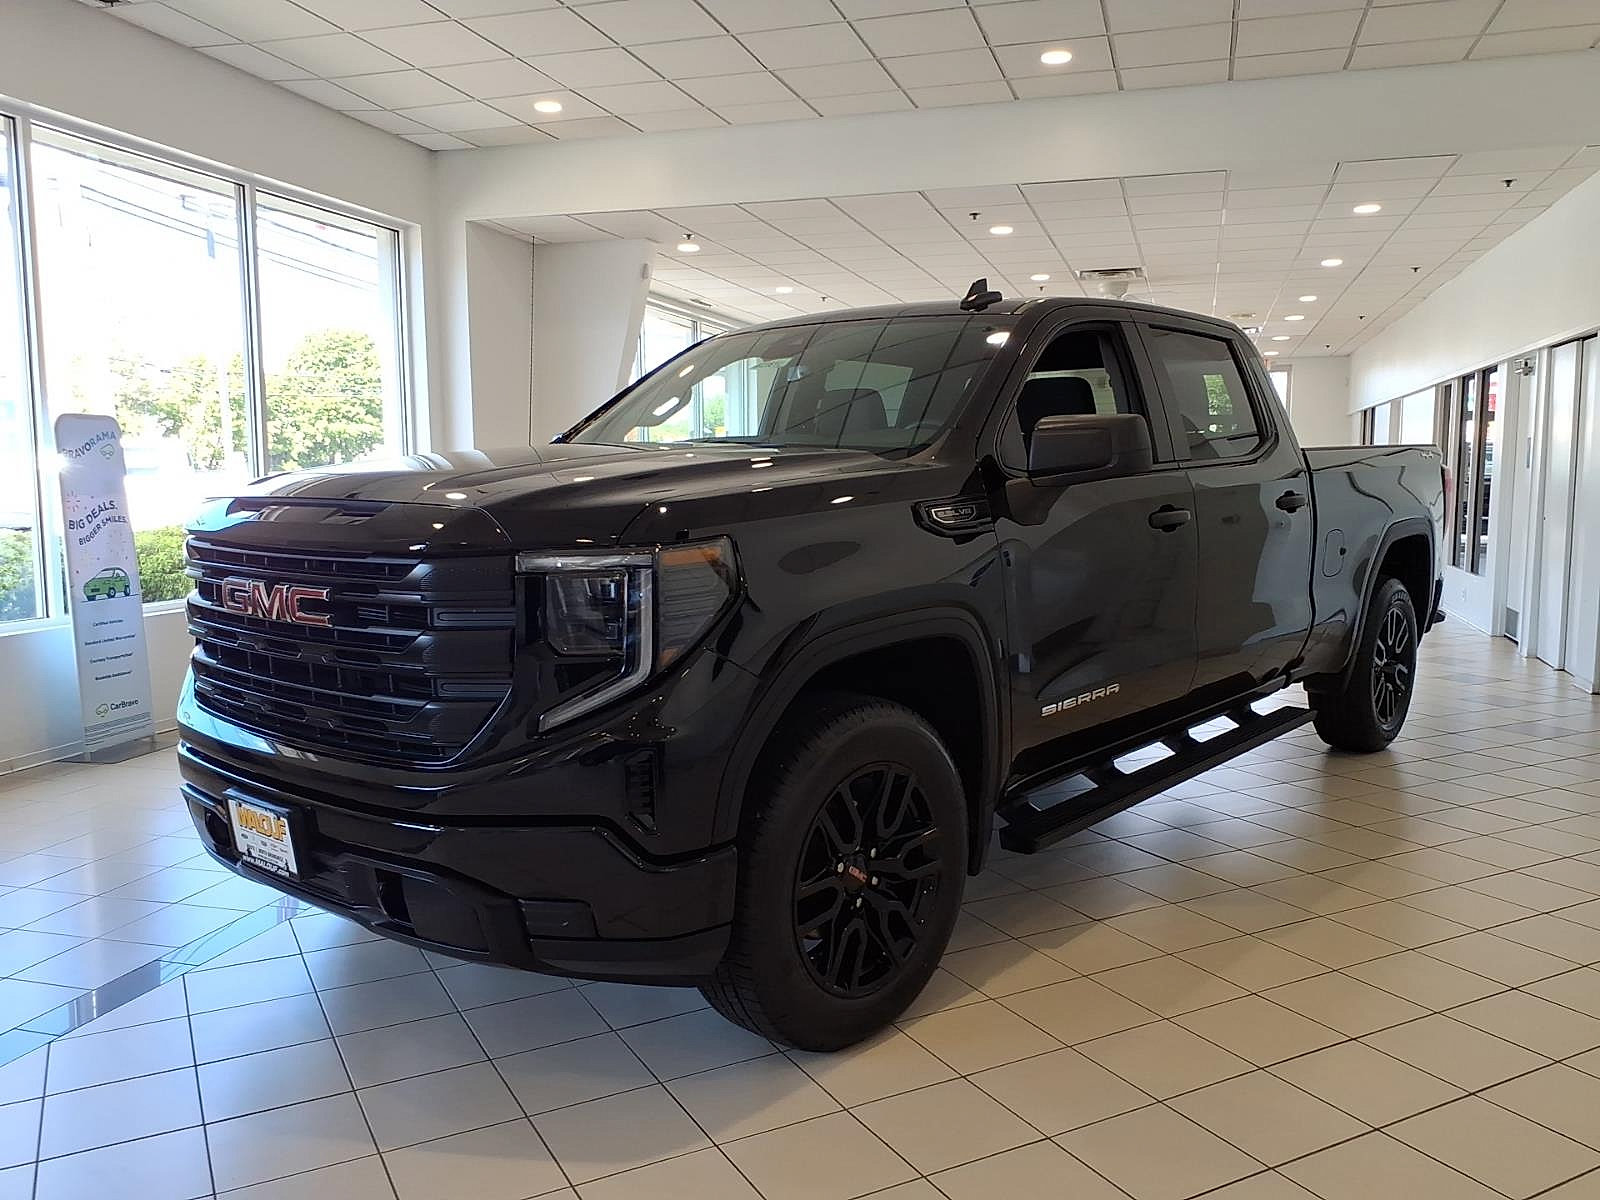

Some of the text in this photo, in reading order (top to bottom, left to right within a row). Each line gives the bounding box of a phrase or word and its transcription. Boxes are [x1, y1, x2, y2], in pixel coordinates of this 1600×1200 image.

[68, 519, 86, 531] BIG
[78, 523, 102, 546] BIGGER
[221, 576, 333, 627] GMC
[1041, 683, 1120, 717] SIERRA
